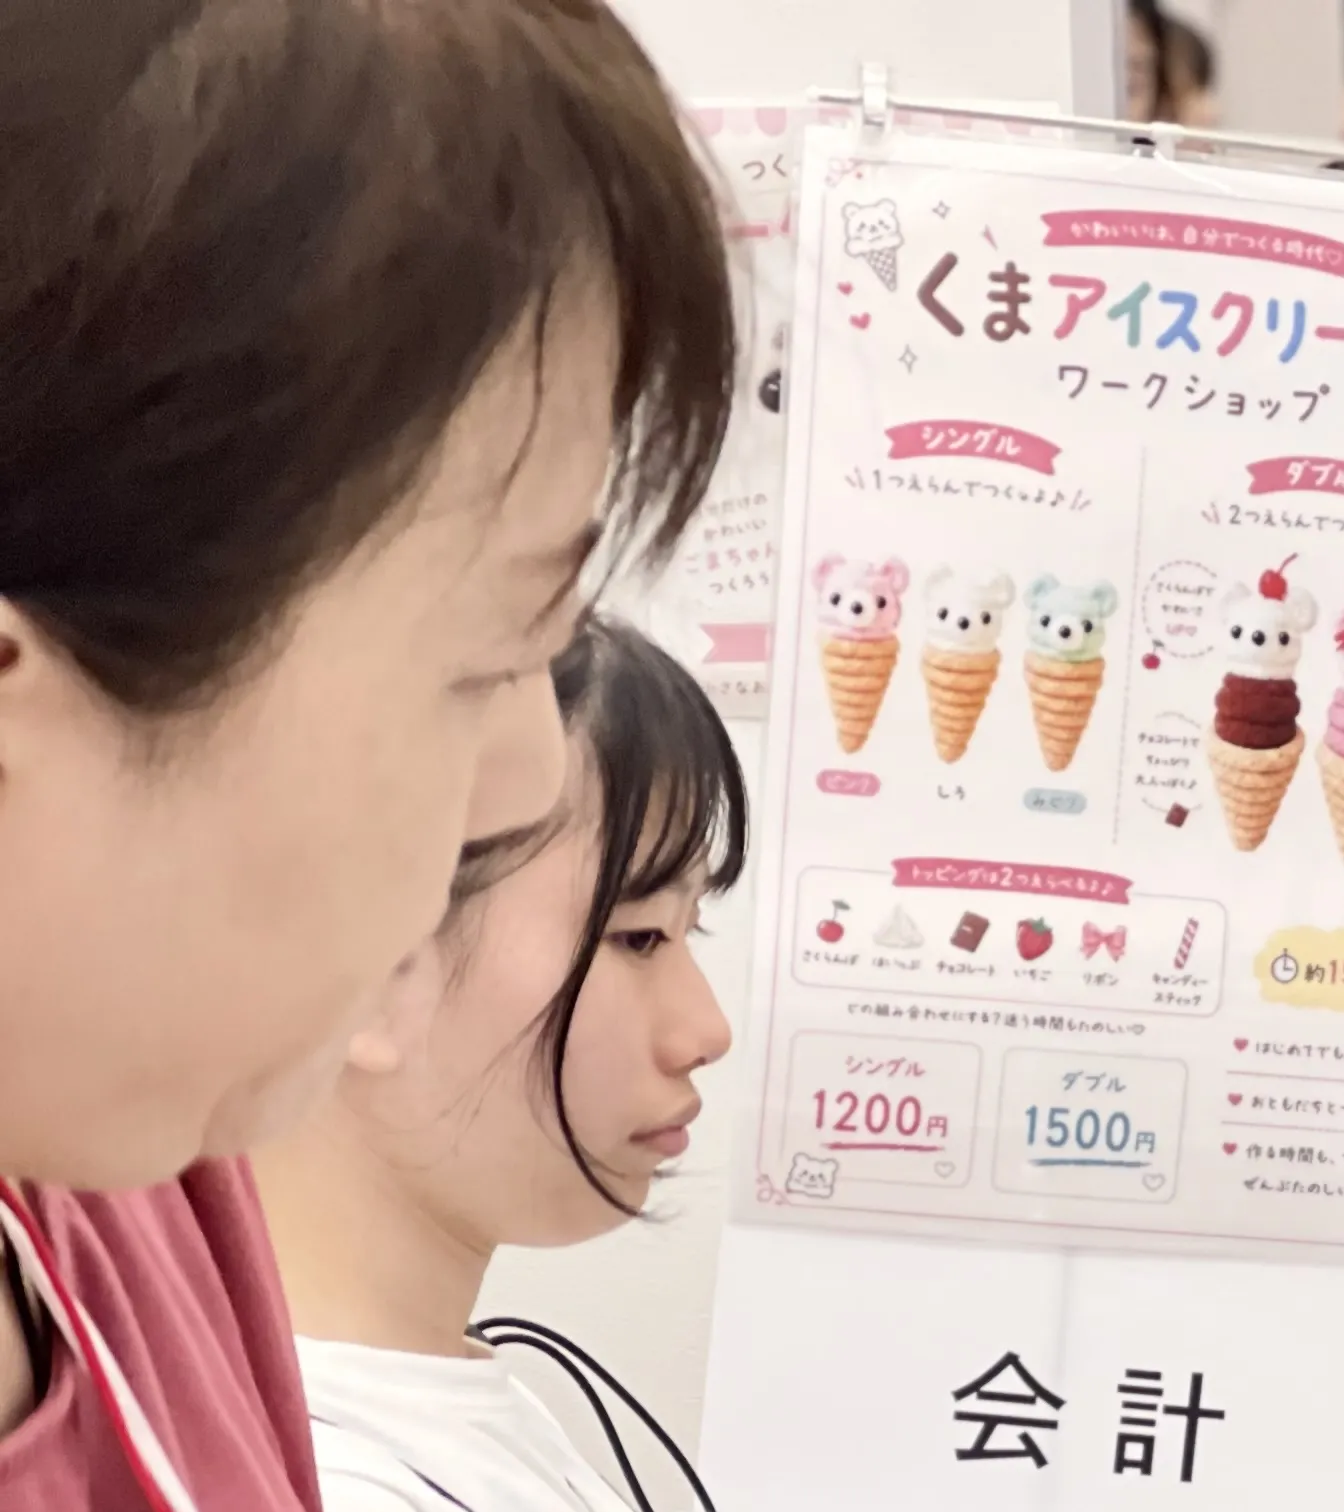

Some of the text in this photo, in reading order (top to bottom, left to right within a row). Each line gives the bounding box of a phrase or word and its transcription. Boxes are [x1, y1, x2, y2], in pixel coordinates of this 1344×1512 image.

[1058, 364, 1331, 421] ワークショップ
[921, 426, 1021, 456] シングル
[936, 960, 995, 977] チョコレート
[845, 1055, 926, 1079] シングル
[1061, 1070, 1127, 1094] ダブル
[812, 1088, 949, 1138] 1200円
[1024, 1104, 1156, 1155] 1500円
[950, 1349, 1226, 1484] 会計
